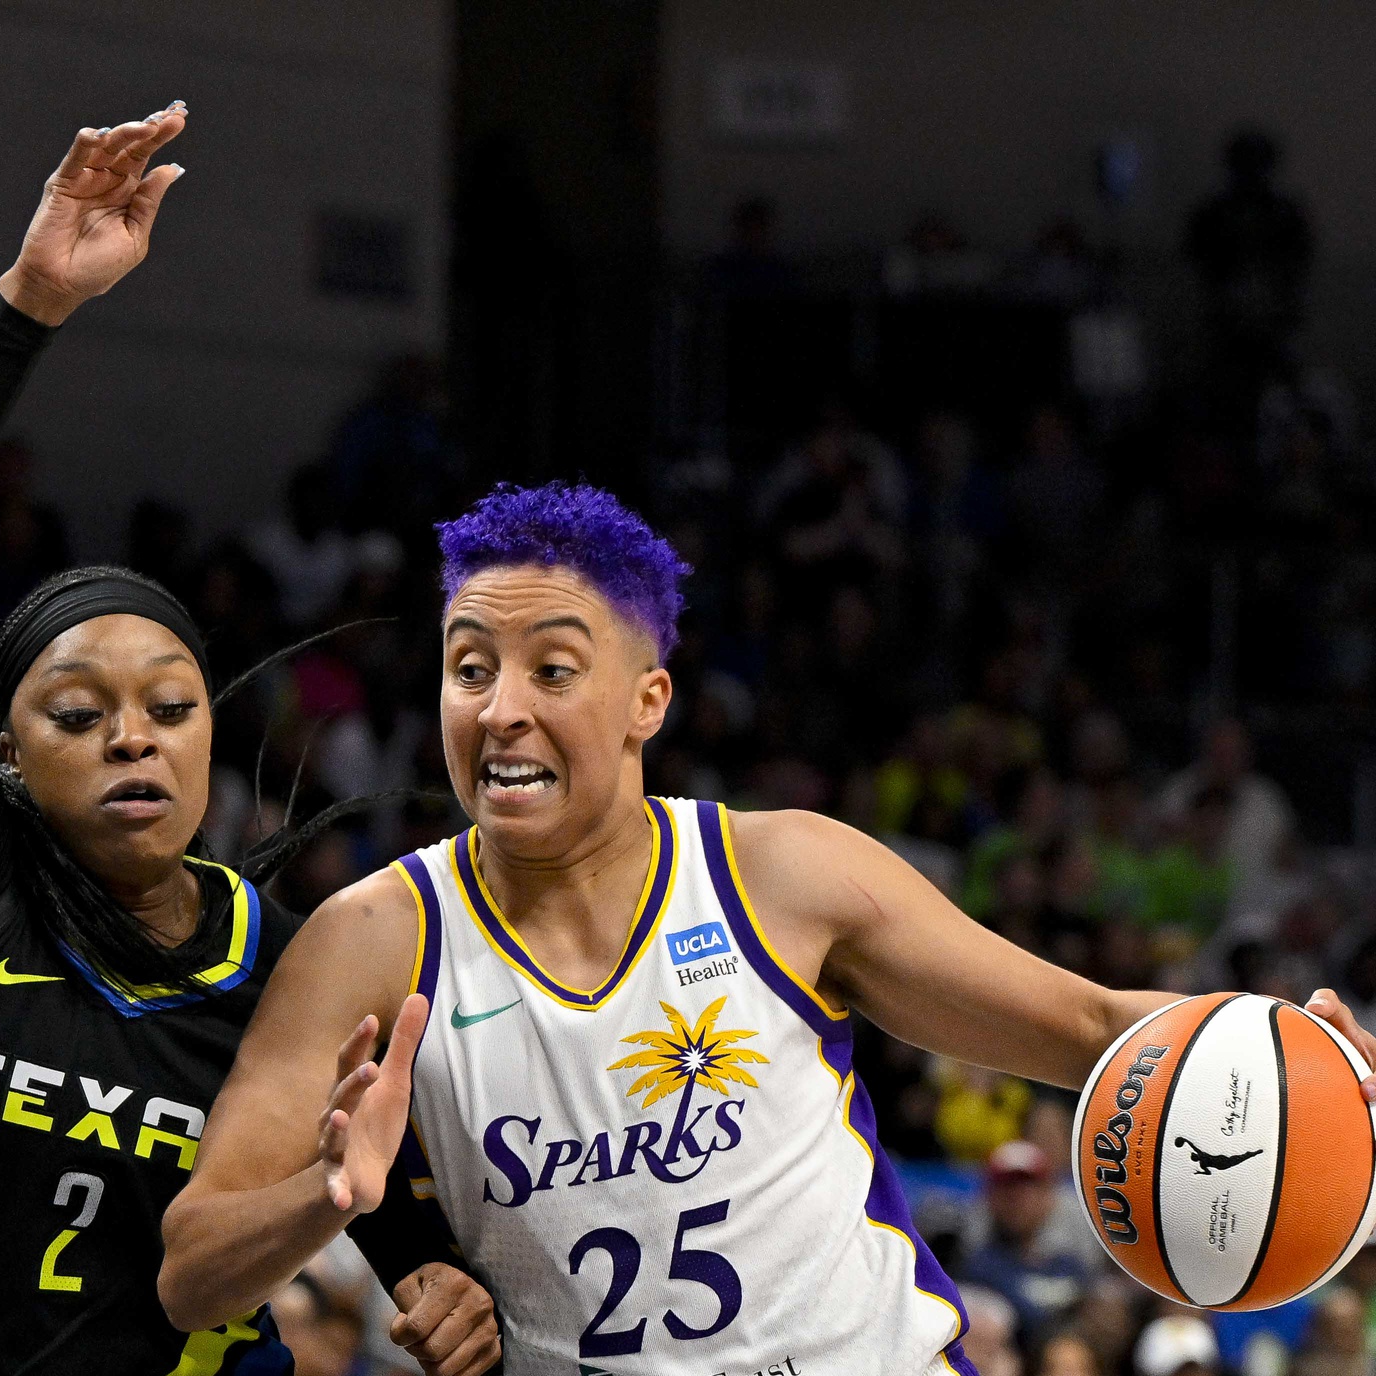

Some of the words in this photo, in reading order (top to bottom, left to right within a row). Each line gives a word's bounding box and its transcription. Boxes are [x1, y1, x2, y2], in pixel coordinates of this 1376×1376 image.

[675, 930, 723, 956] UCLA
[1093, 1045, 1170, 1246] Wilson
[1208, 1196, 1219, 1245] OFFICIAL
[1220, 1189, 1230, 1220] BALL
[38, 1171, 105, 1292] 2
[1218, 1221, 1227, 1252] GAME
[568, 1198, 743, 1359] 25
